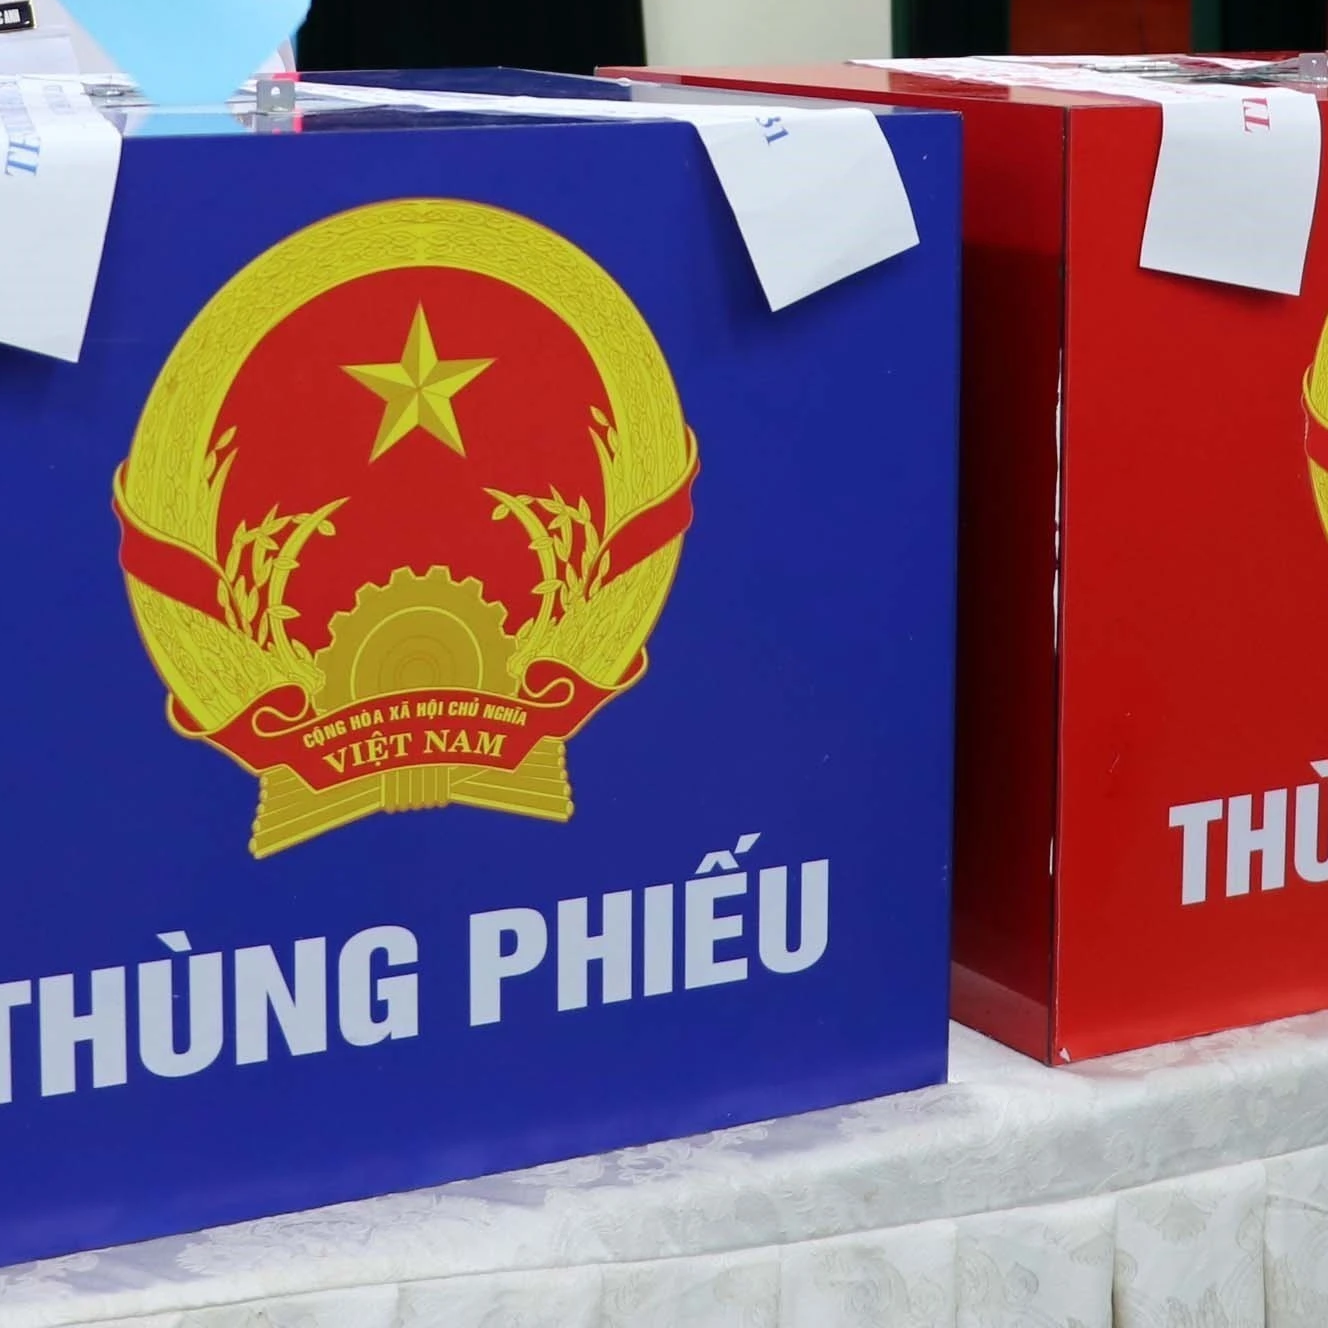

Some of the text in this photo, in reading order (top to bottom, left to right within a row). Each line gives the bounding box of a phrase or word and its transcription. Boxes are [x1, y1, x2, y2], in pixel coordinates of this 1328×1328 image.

[302, 697, 528, 749] CỘNG HÒA XÃ HỘI CHỦ NGHĨA
[323, 729, 507, 773] VIỆT NAM
[469, 832, 831, 1028] PHIẾU
